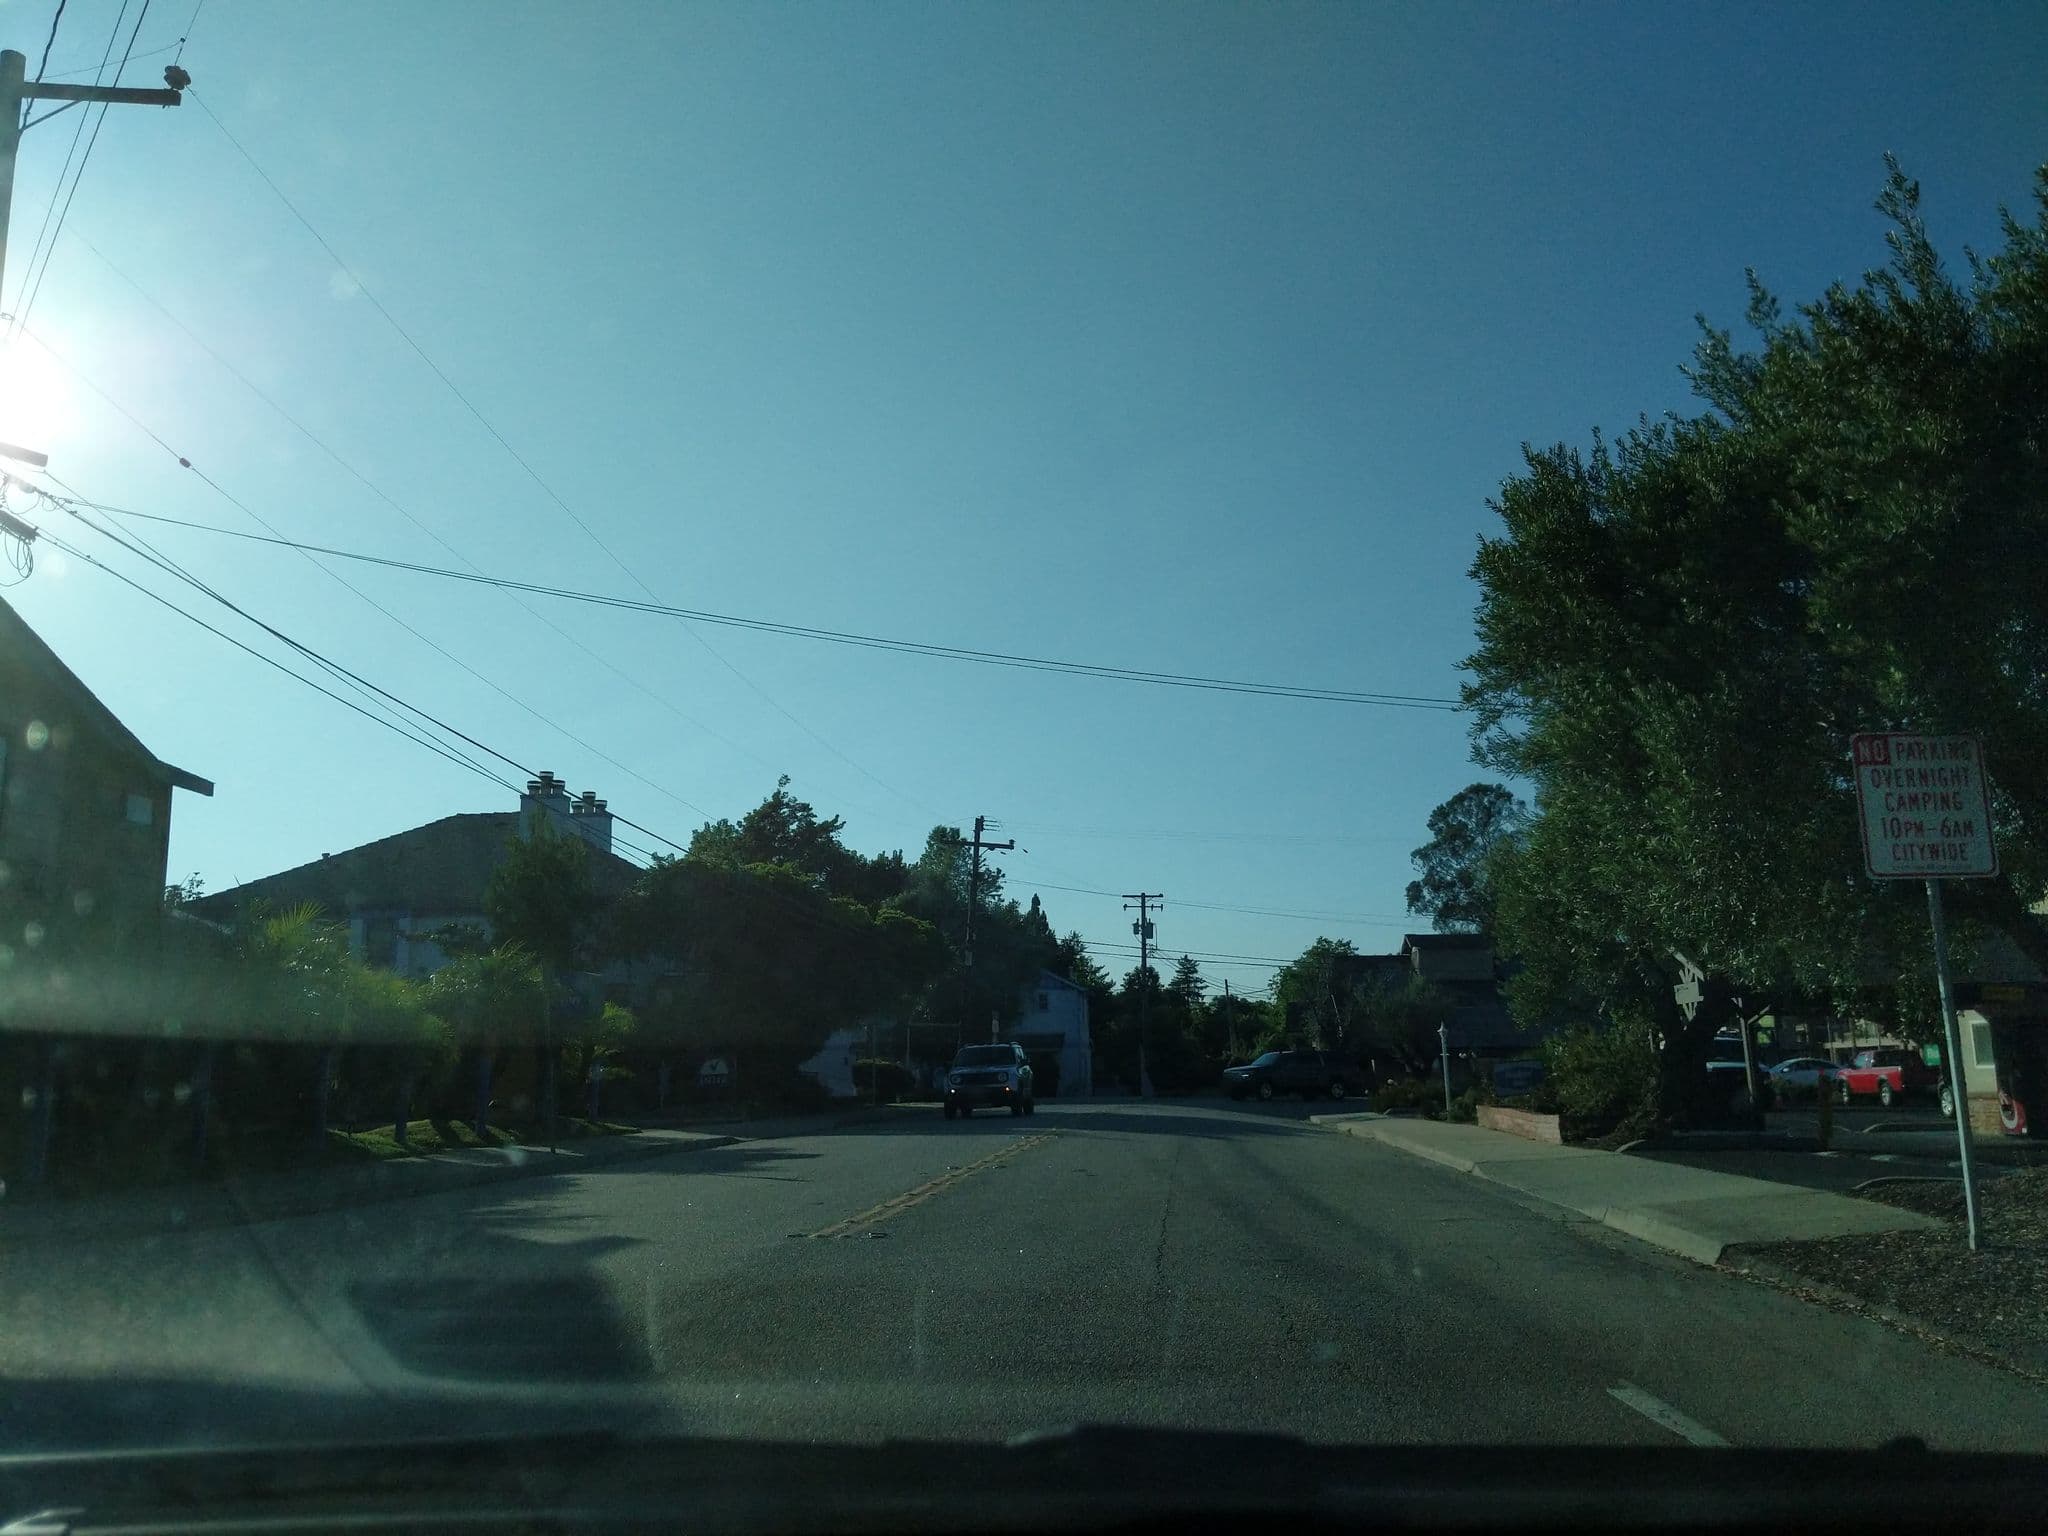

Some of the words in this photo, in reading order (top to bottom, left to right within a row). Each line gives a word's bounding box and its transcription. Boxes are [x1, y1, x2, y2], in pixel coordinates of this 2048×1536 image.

[1859, 739, 1887, 763] NO
[1896, 739, 1971, 761] PARKING
[1871, 767, 1971, 788] OVERNIGHT
[1885, 791, 1962, 812] CAMPING
[1892, 843, 1968, 861] CITYWIDE
